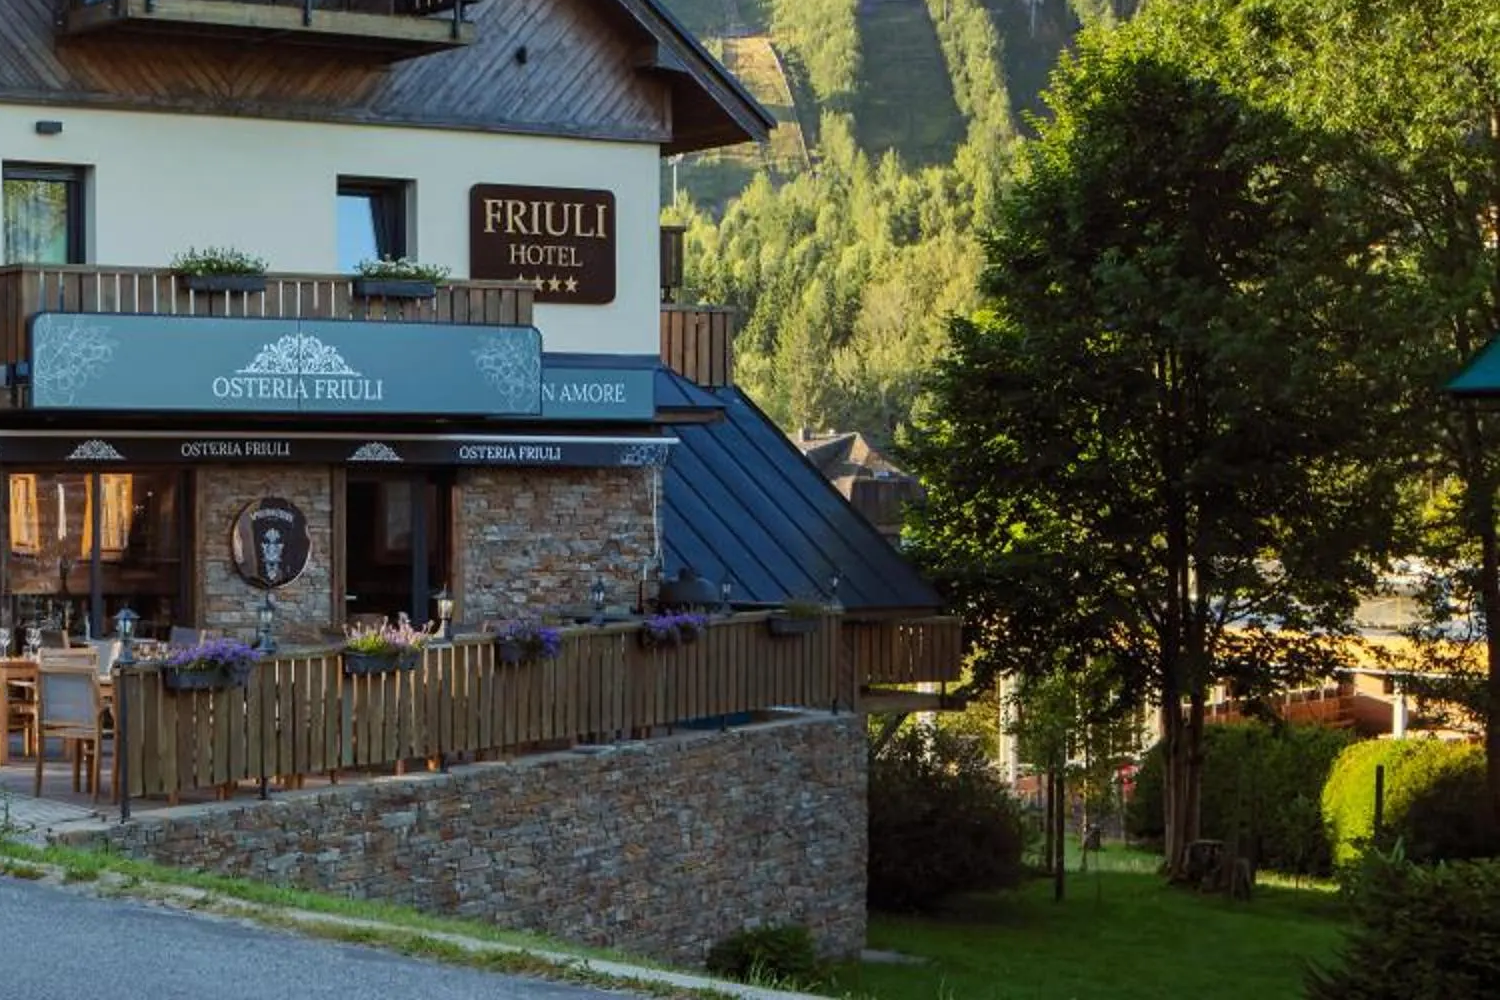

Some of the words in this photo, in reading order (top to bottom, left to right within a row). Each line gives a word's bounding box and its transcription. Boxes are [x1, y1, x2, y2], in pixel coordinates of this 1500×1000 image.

[483, 198, 608, 238] FRIULI
[508, 243, 584, 268] HOTEL
[211, 375, 309, 399] OSTERIA
[314, 378, 384, 401] FRIULI
[559, 383, 627, 404] AMORE
[180, 441, 242, 457] OSTERIA
[245, 441, 291, 456] FRIULI
[459, 445, 517, 460] OSTERIA
[519, 445, 562, 461] FRIULI
